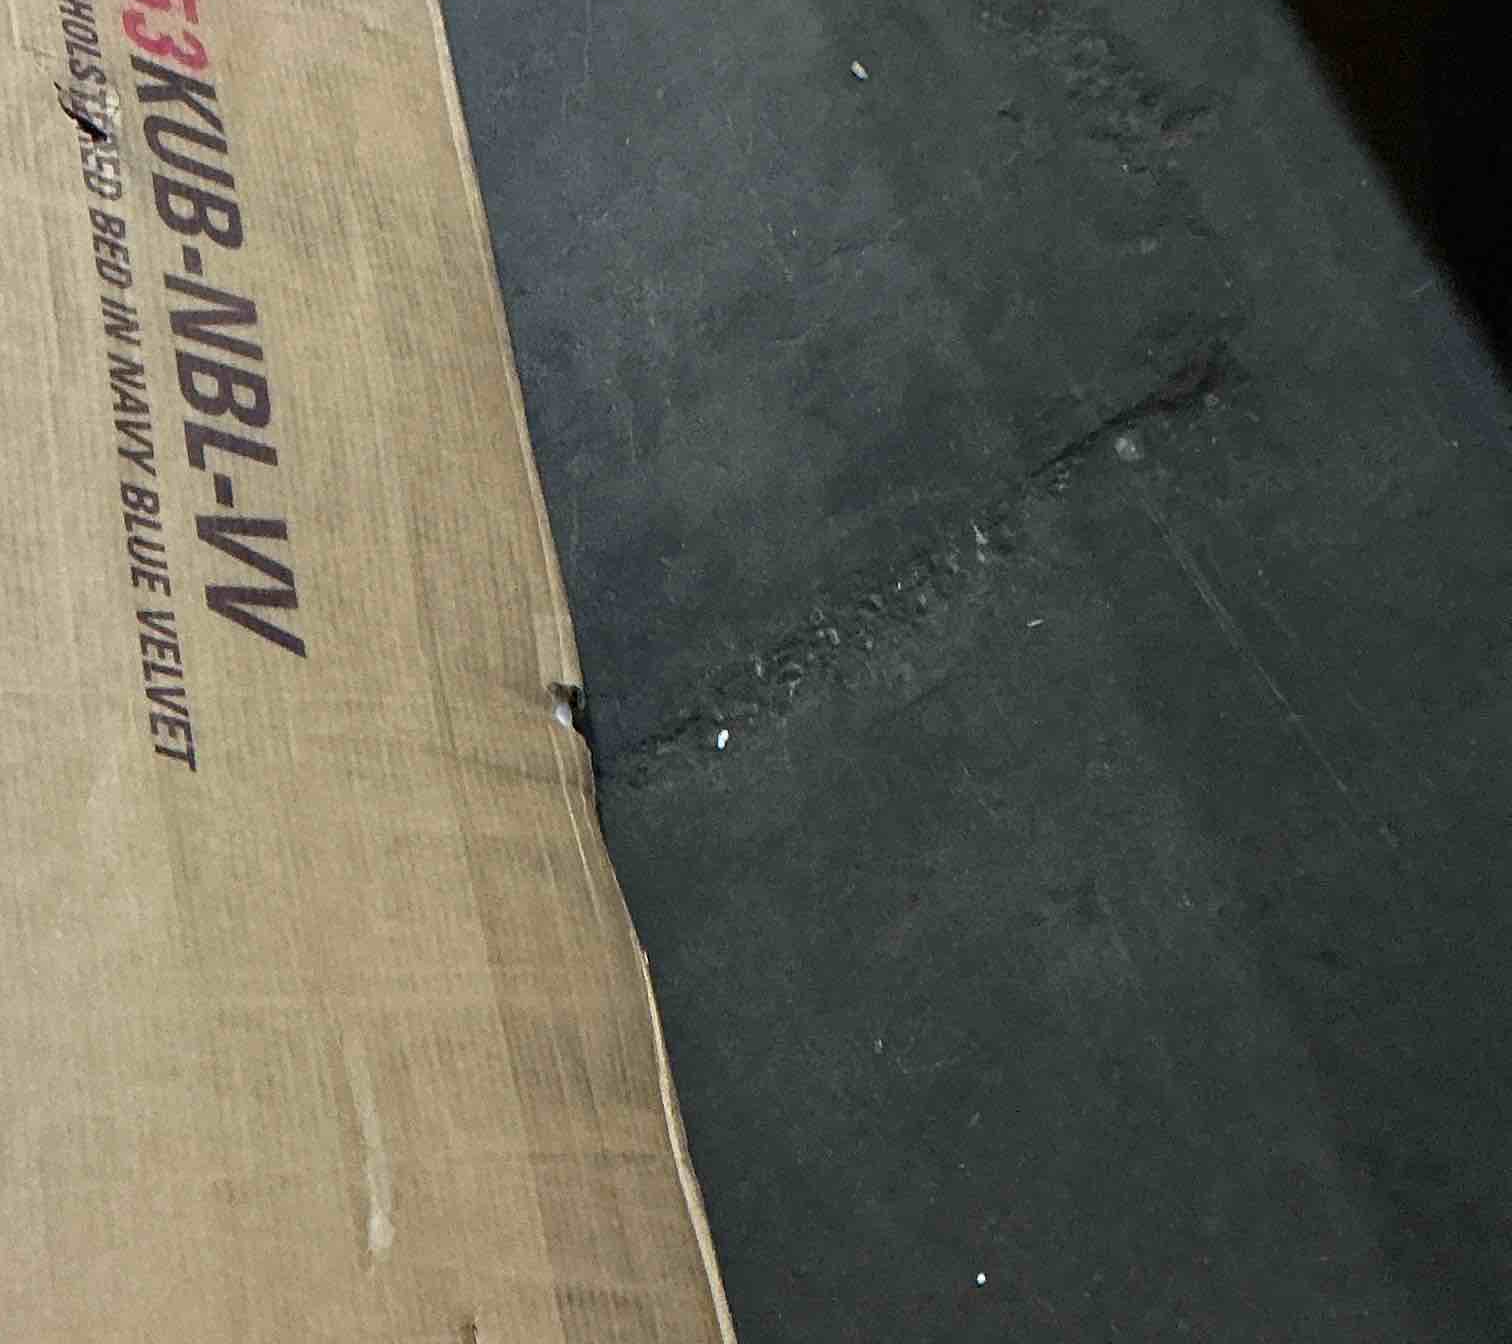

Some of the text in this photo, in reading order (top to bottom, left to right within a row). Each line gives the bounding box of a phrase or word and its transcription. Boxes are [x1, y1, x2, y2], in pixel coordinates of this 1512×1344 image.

[88, 207, 133, 290] BED
[100, 295, 140, 346] IN
[108, 352, 157, 475] NAVY
[119, 480, 171, 597] BLUE
[136, 609, 197, 772] VELVET
